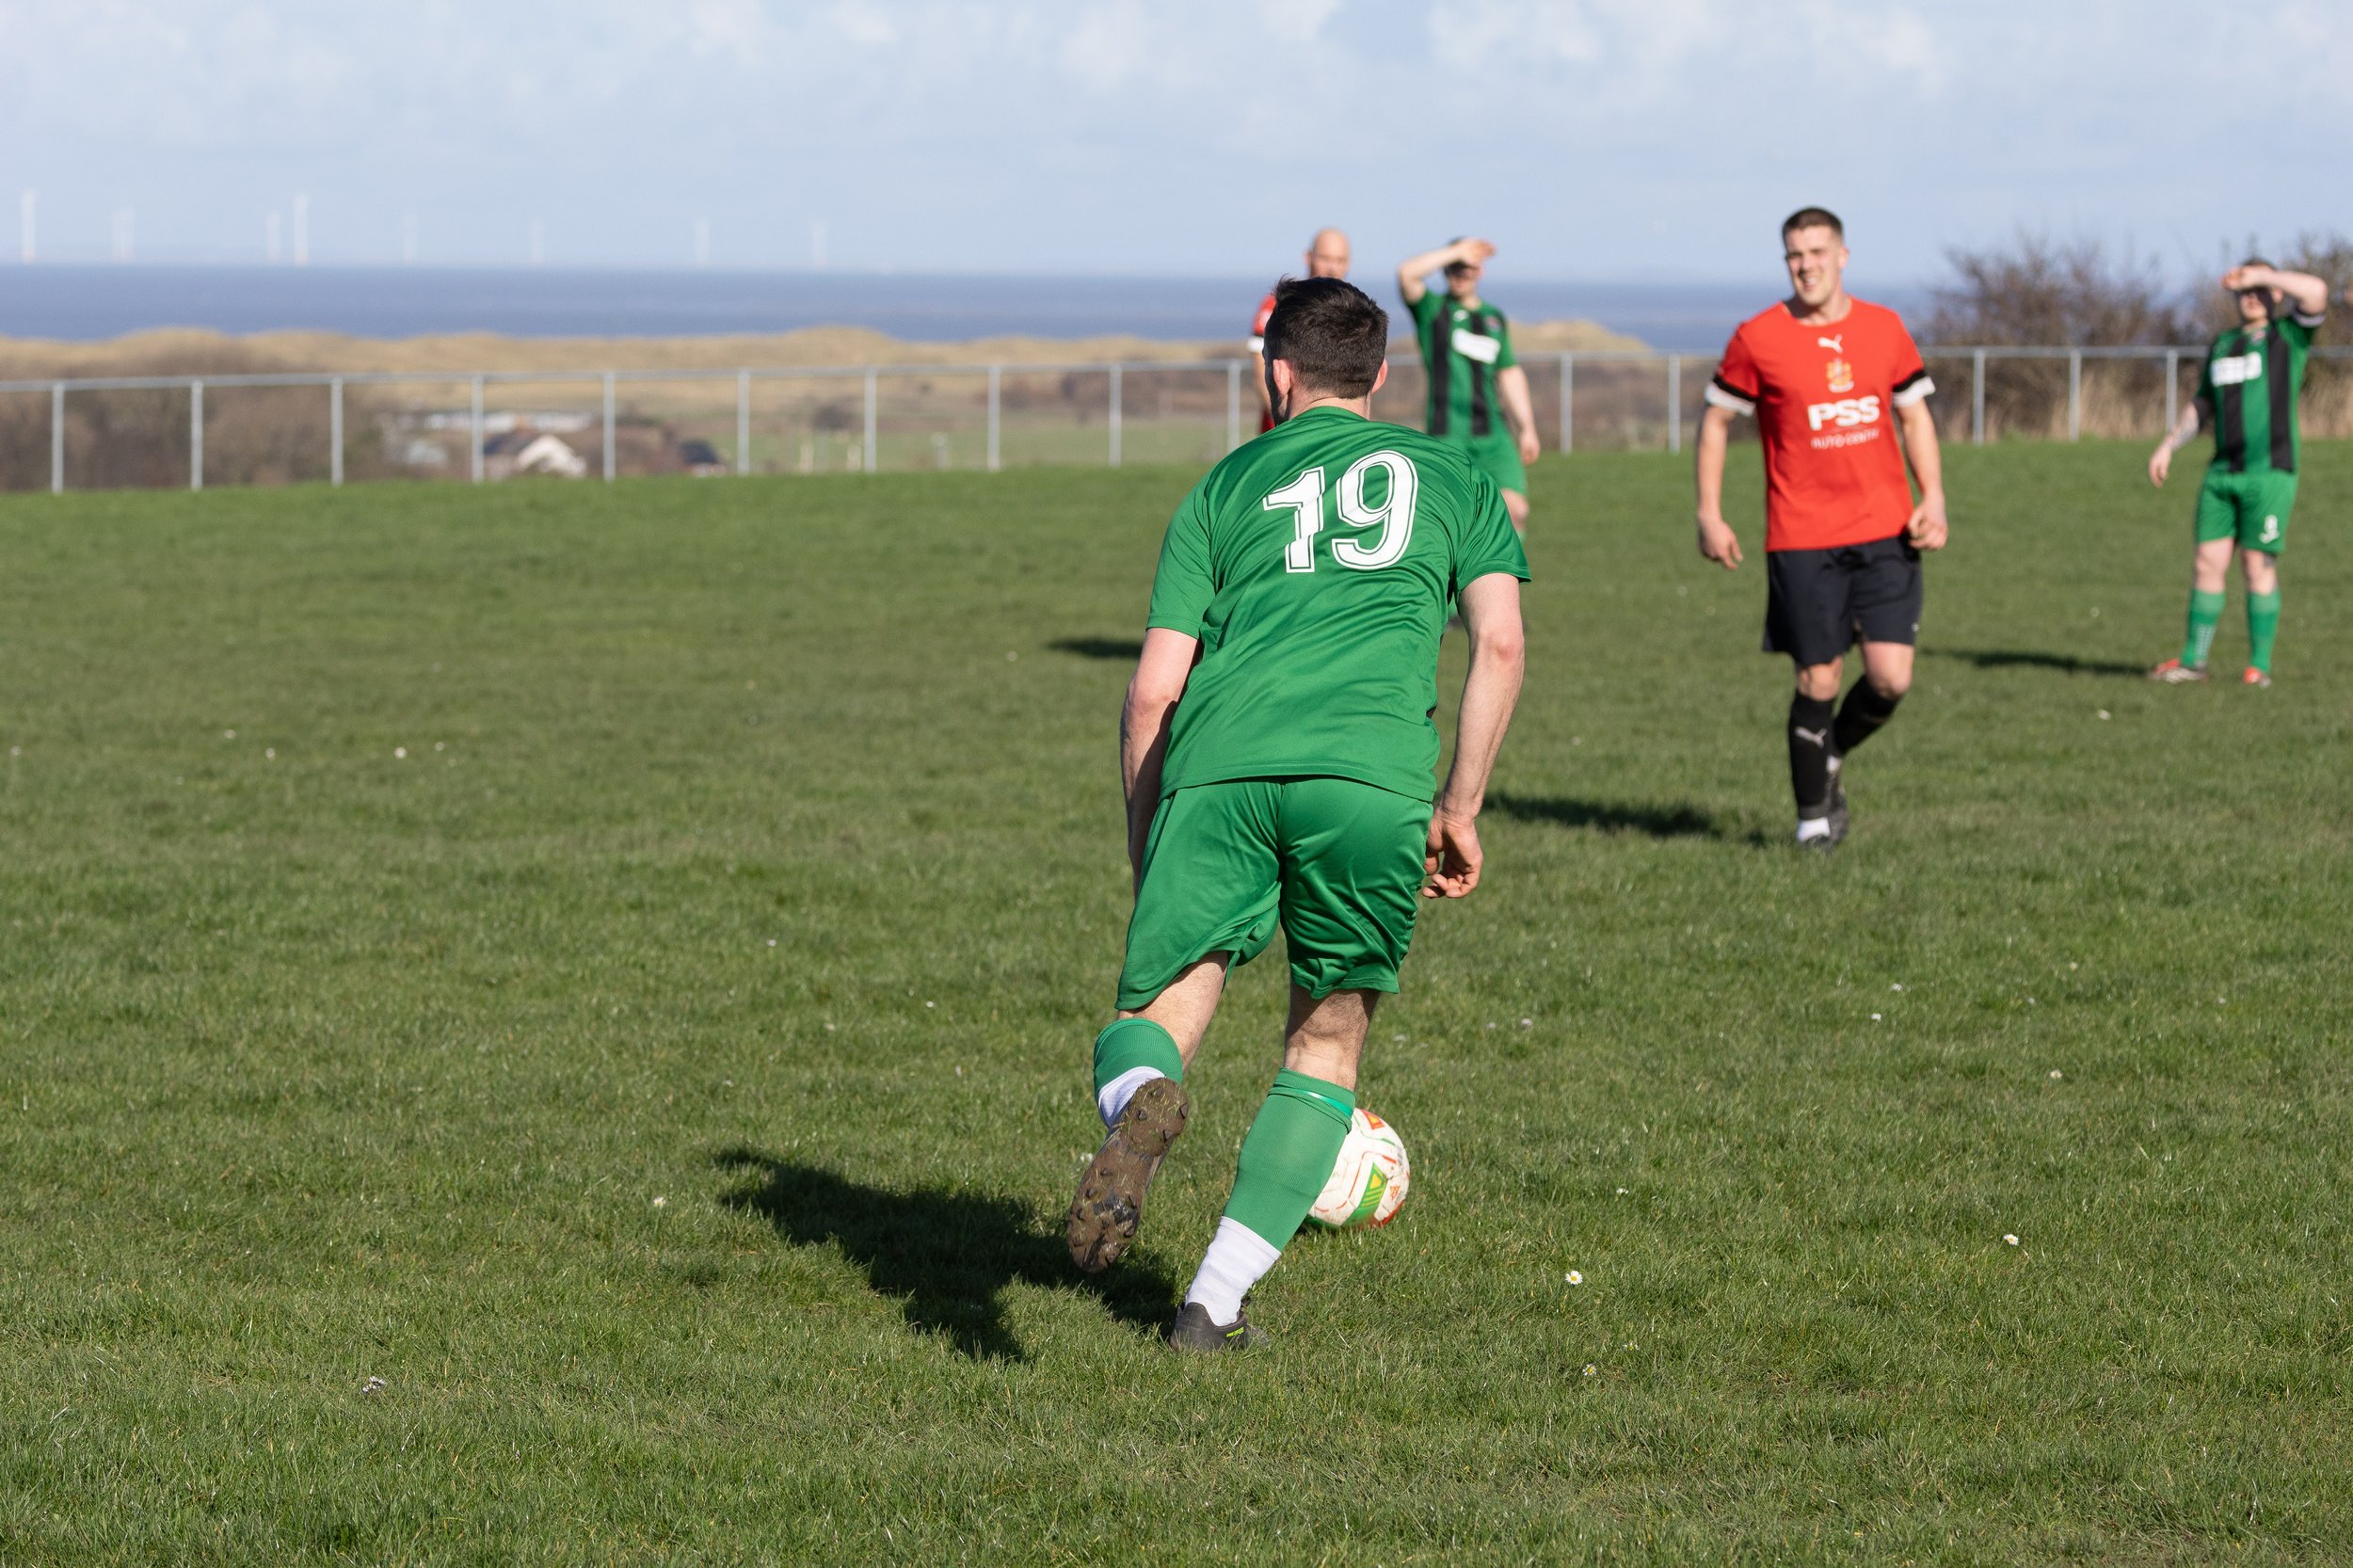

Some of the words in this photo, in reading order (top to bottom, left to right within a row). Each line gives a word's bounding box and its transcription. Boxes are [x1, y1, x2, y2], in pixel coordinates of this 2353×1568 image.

[1808, 395, 1880, 430] PSS
[1811, 434, 1845, 450] AUTO
[1263, 450, 1418, 573] 19
